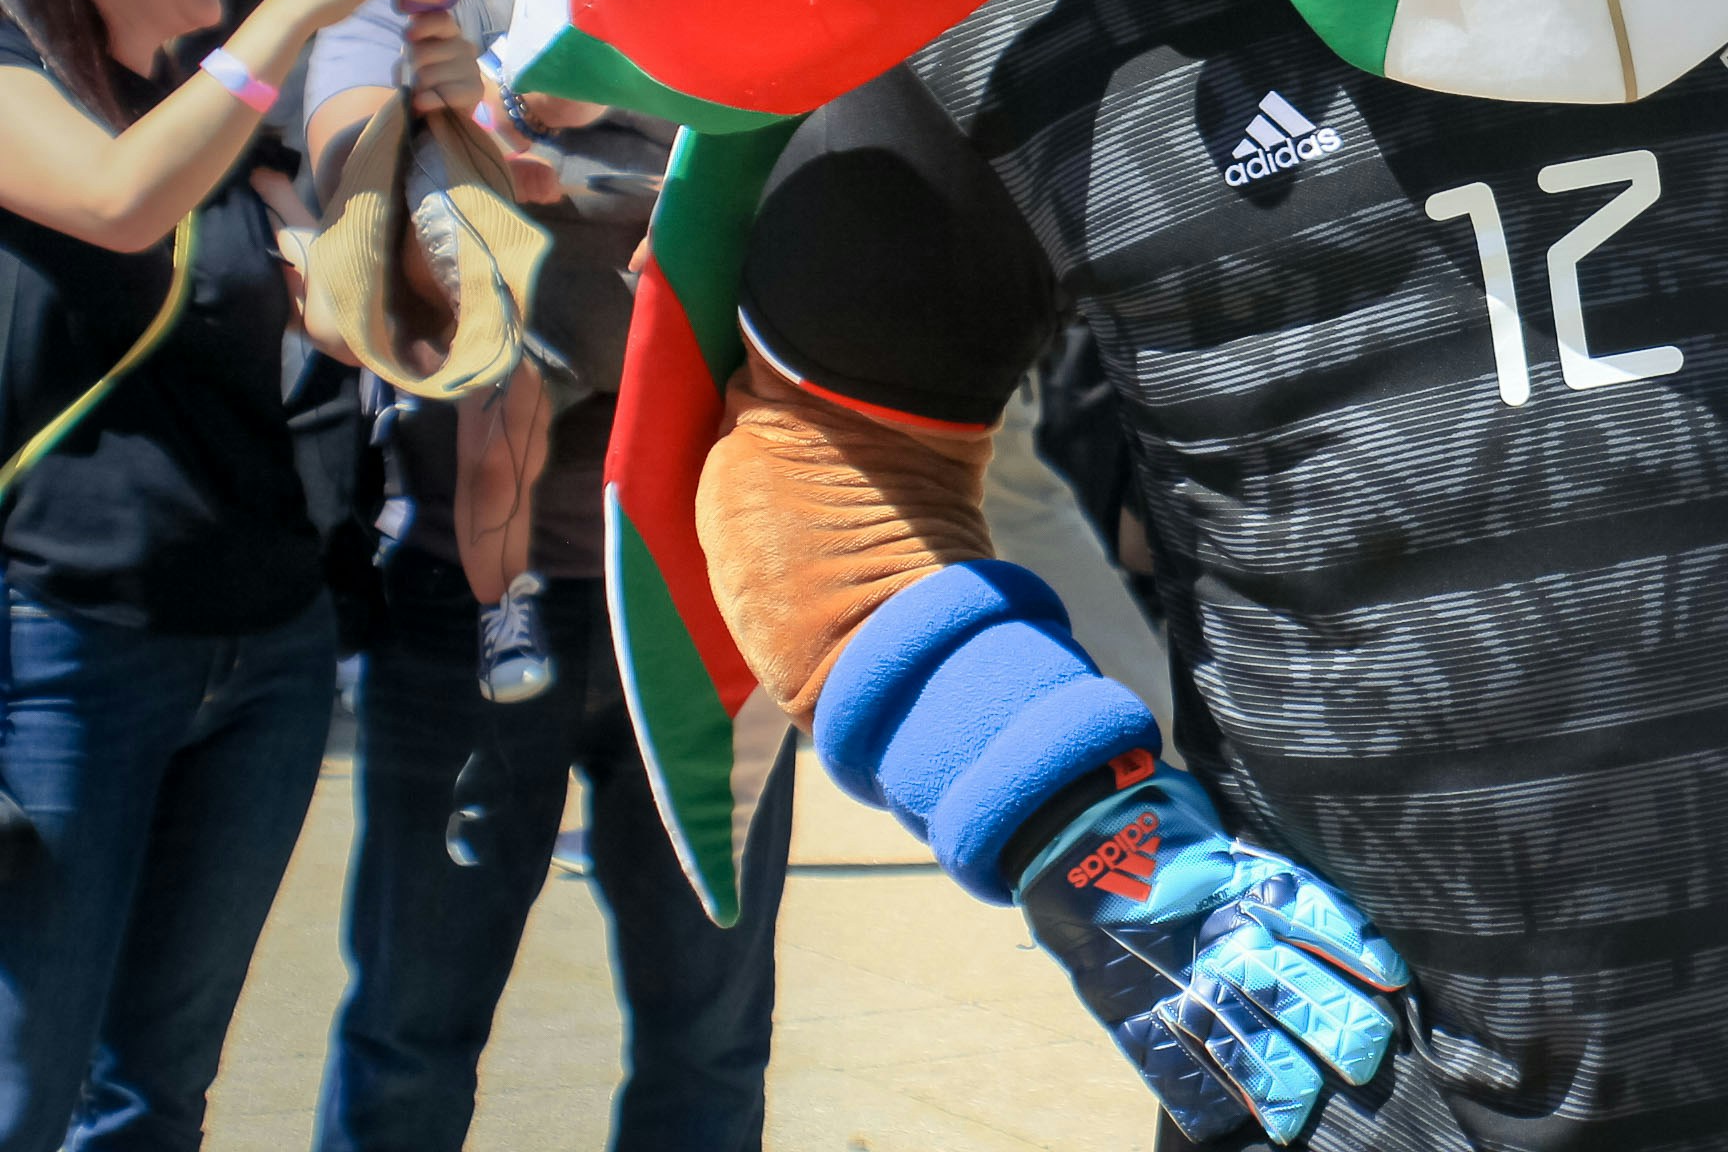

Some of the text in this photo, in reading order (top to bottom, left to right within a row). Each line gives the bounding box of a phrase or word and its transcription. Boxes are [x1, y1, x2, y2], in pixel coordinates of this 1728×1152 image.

[1224, 127, 1343, 187] adidas
[1425, 149, 1684, 407] 12
[1067, 811, 1160, 889] adidas
